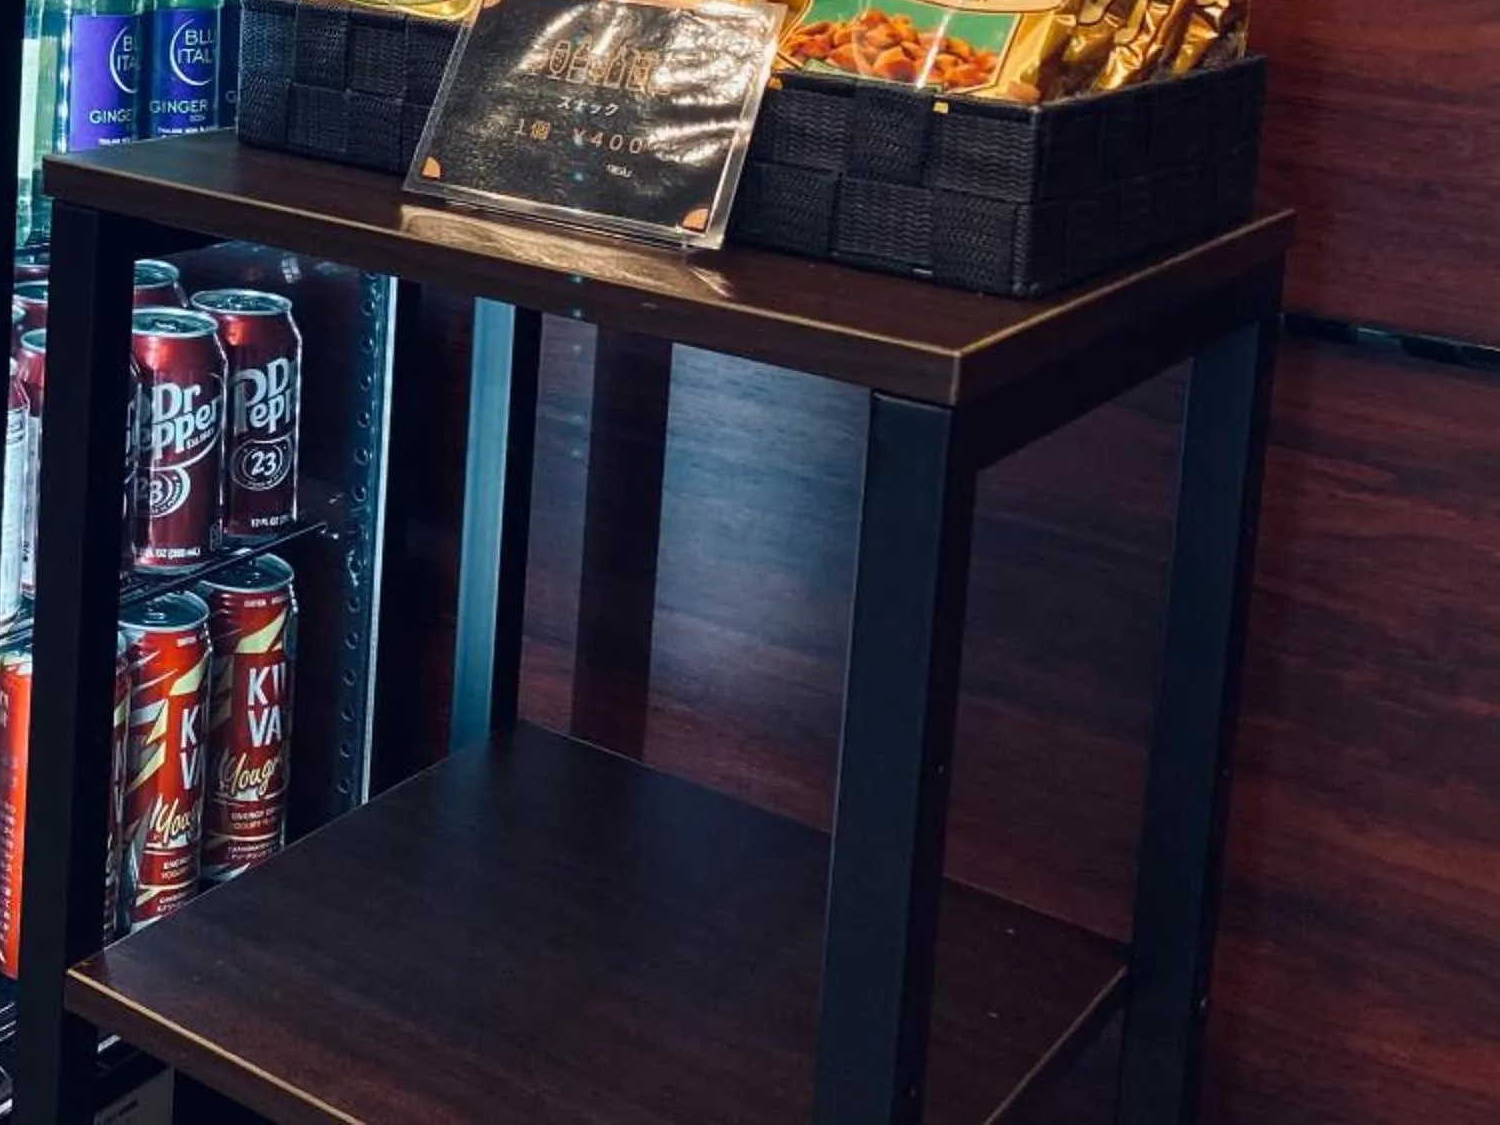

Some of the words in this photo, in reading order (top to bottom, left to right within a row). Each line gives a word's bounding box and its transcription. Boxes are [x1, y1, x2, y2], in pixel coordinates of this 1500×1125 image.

[177, 48, 214, 65] ITAL
[89, 108, 133, 124] GINGE
[150, 99, 209, 115] GINGER
[152, 382, 201, 423] Dr
[250, 451, 277, 476] 23
[248, 705, 282, 748] VA
